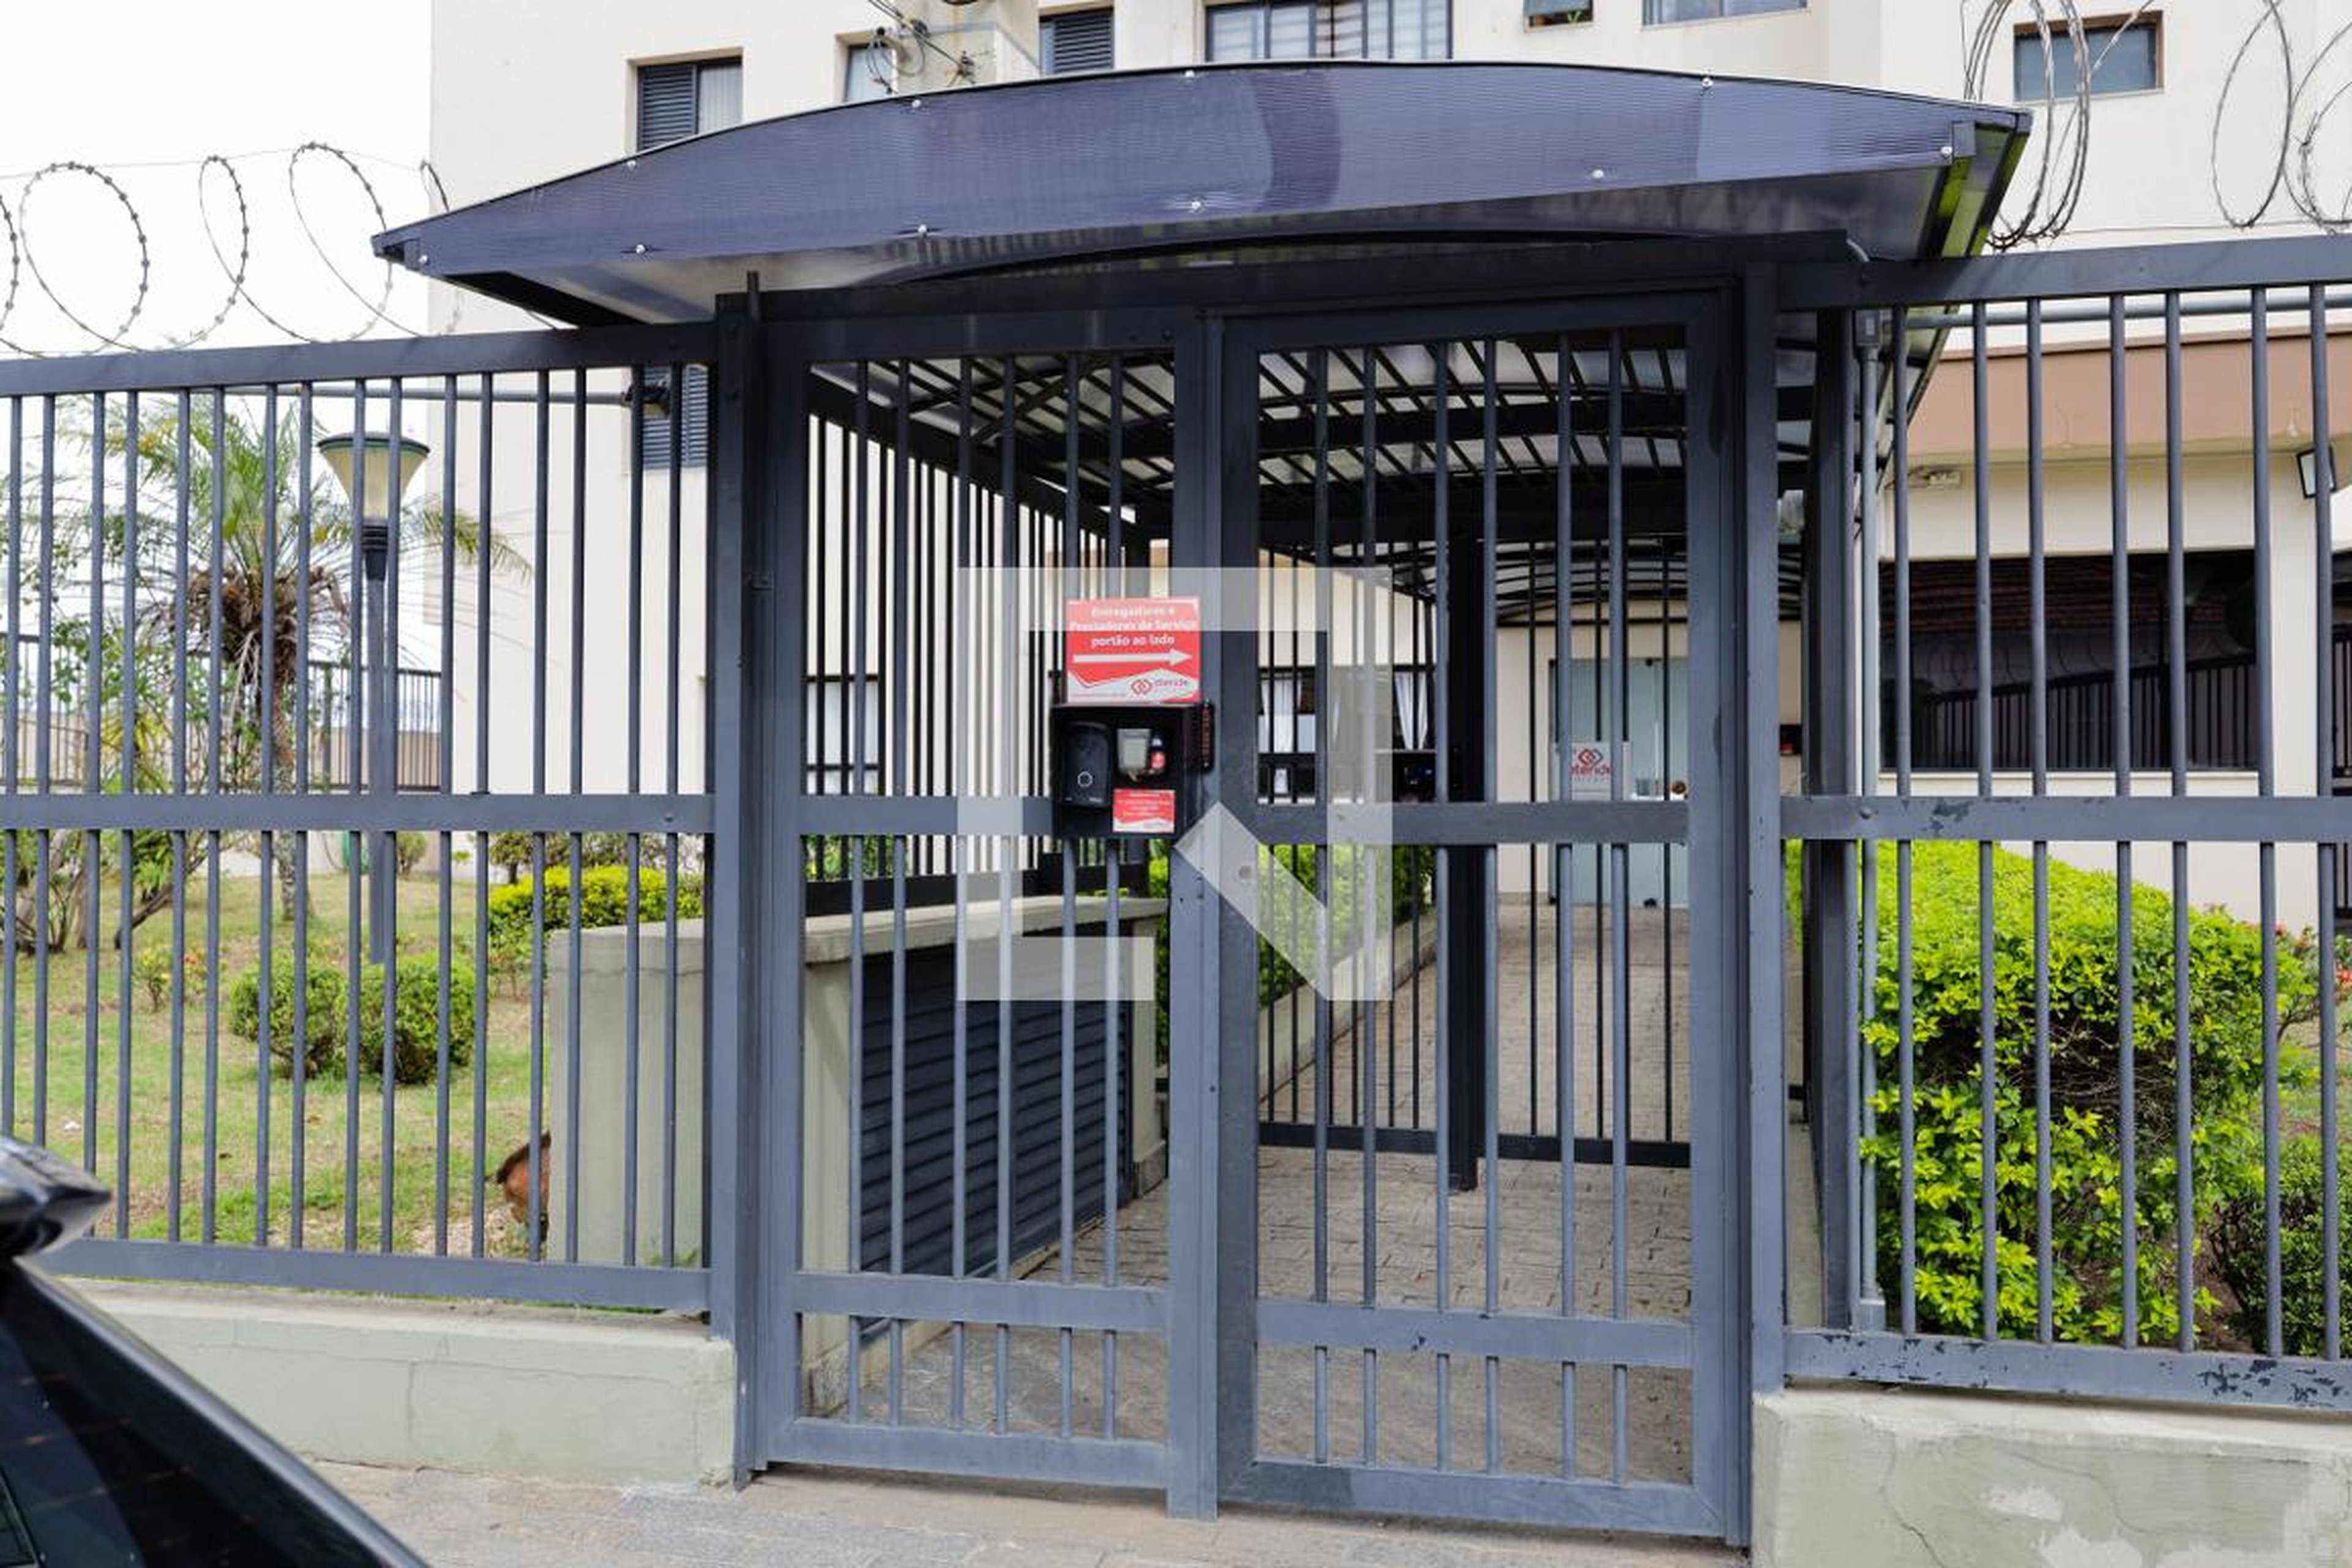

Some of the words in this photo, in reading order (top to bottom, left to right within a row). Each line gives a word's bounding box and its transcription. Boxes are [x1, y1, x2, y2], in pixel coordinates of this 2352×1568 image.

[1091, 634, 1130, 648] portão
[1132, 637, 1147, 646] ao
[1149, 633, 1175, 645] lado
